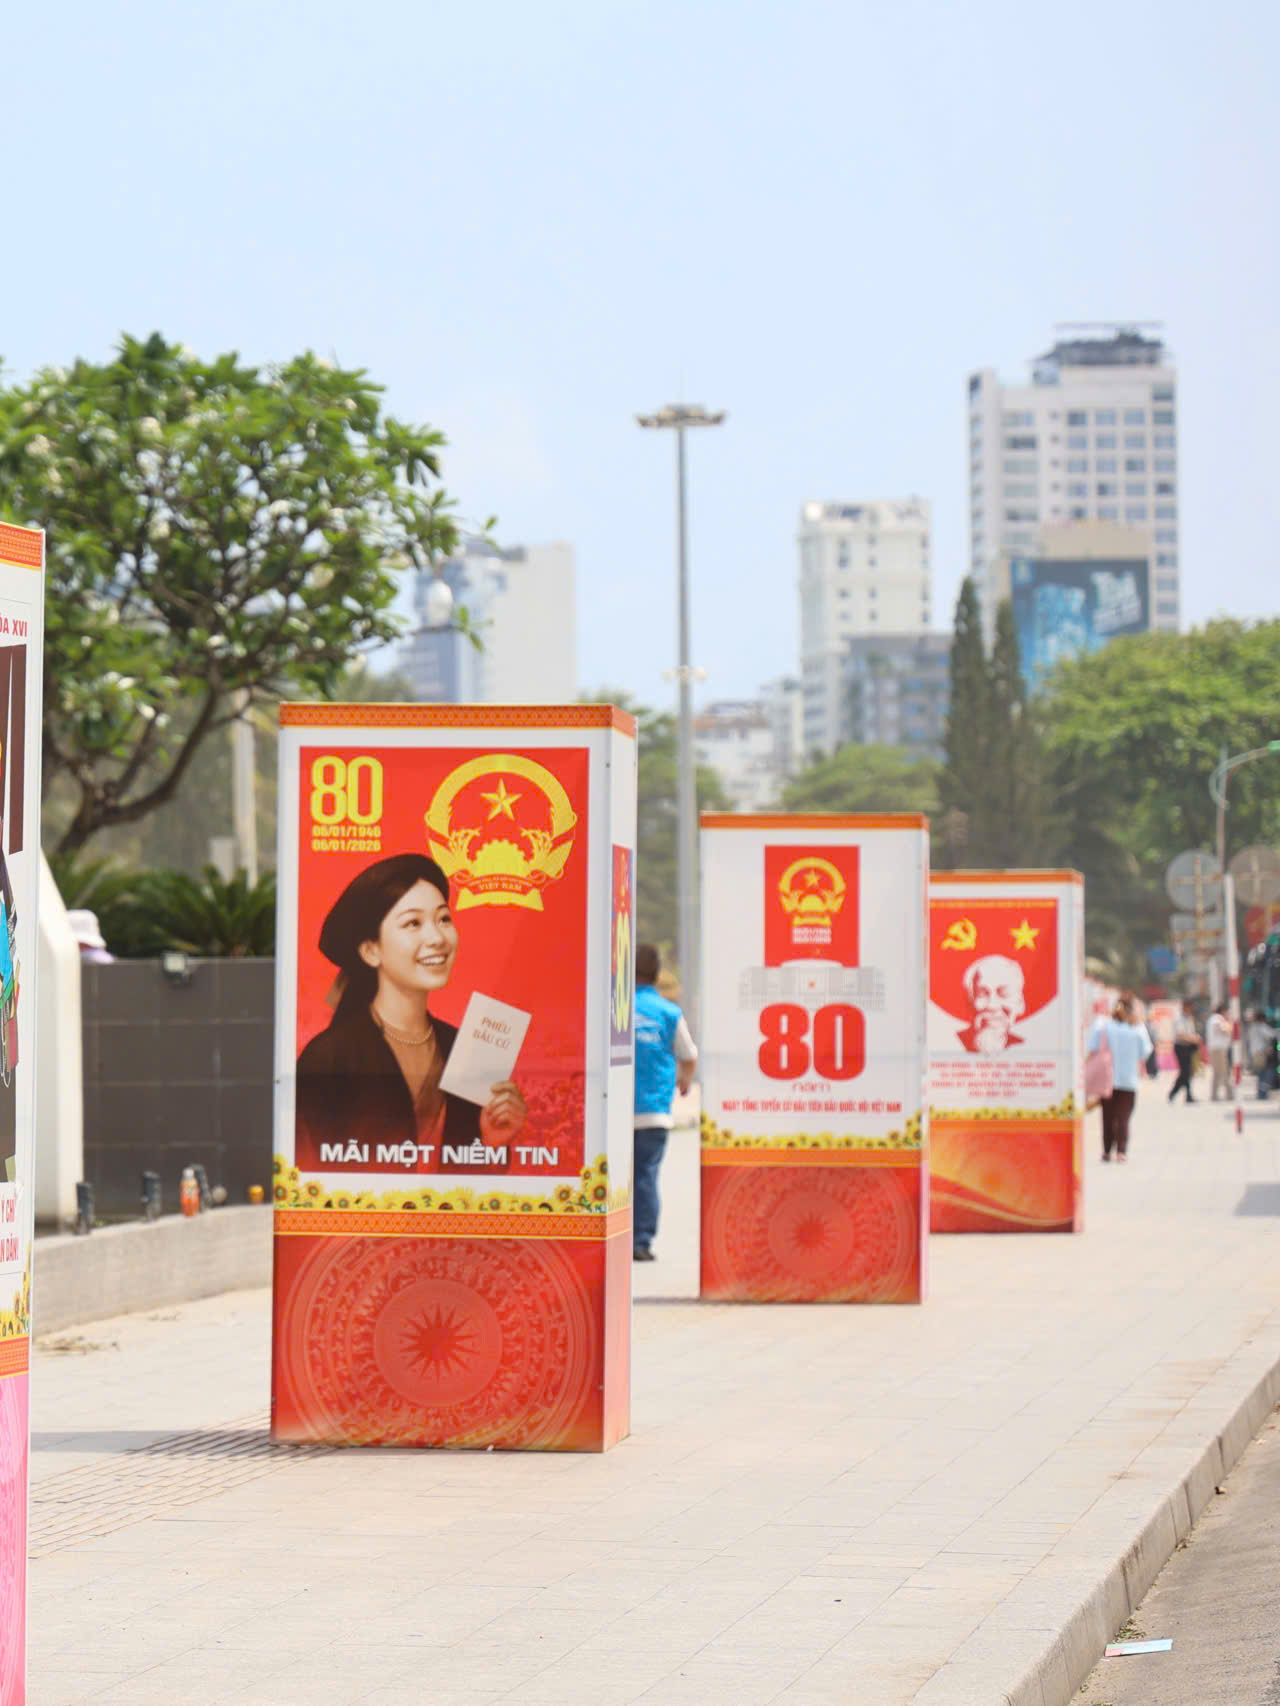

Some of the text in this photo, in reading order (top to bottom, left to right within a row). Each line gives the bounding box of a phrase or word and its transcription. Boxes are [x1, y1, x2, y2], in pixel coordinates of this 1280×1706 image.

[12, 618, 28, 637] XVI
[311, 755, 383, 824] 80
[758, 1002, 866, 1080] 80
[320, 1138, 559, 1168] MÃI MỘT NIỀM TIN
